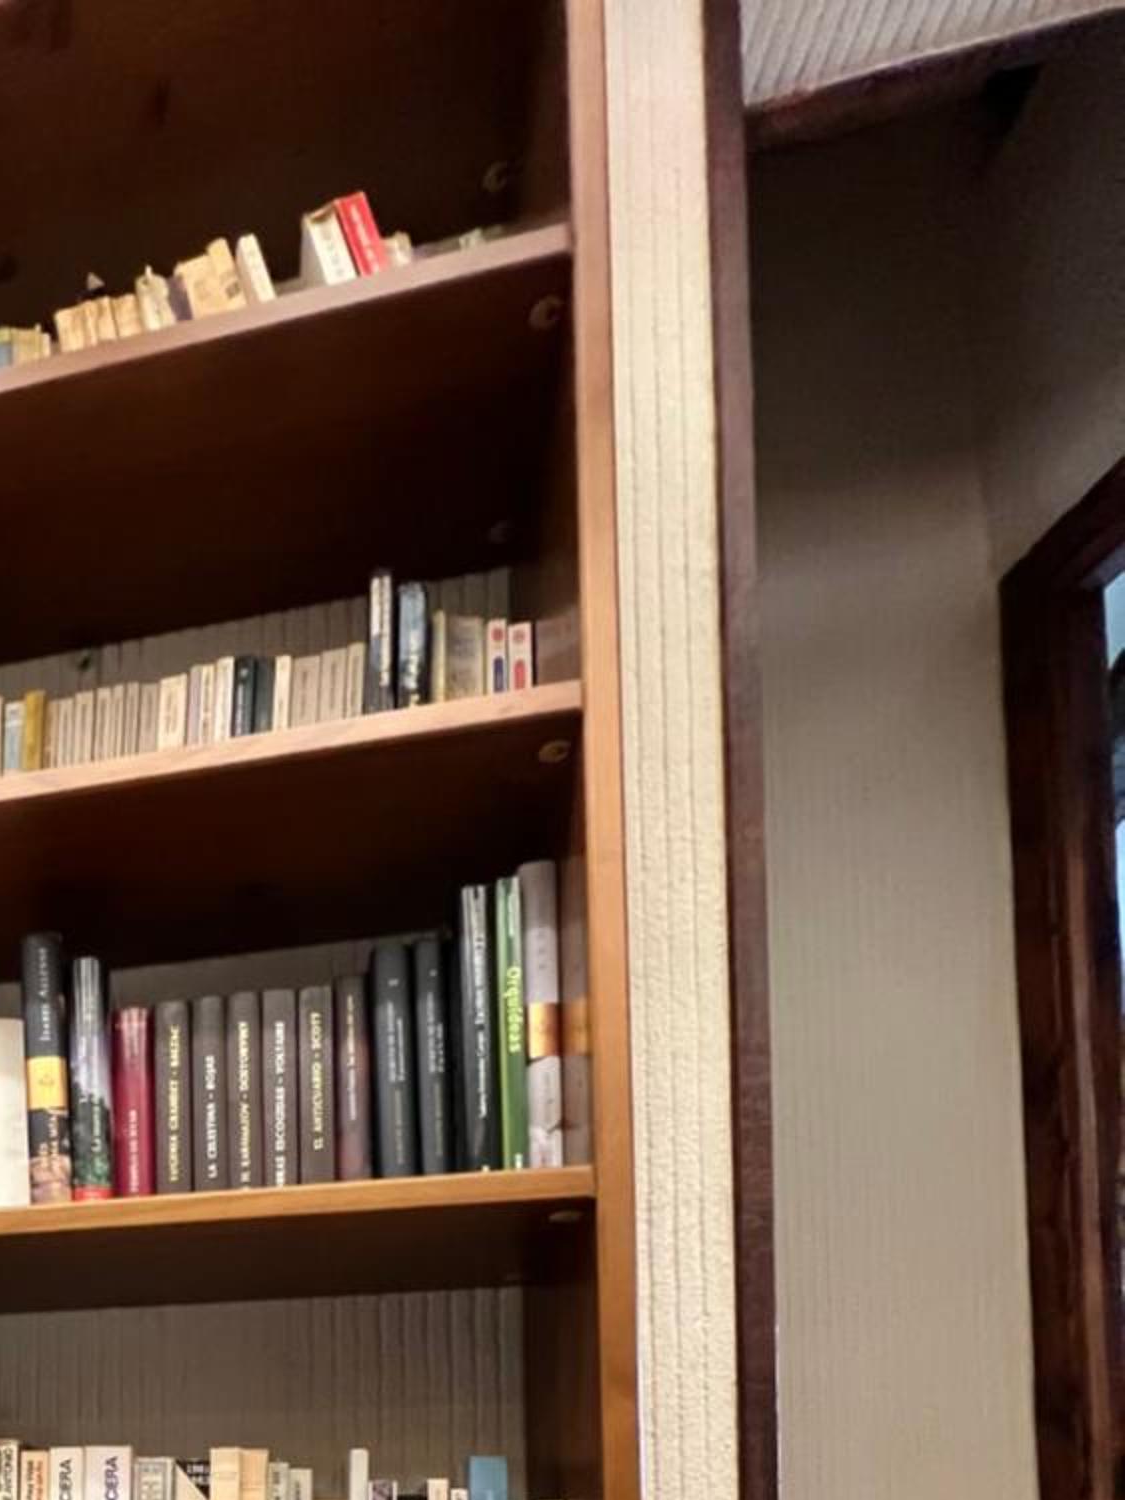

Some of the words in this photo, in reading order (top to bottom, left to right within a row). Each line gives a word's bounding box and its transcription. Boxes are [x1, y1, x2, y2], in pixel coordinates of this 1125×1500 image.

[504, 965, 523, 1054] Orquídeas
[310, 1011, 323, 1051] SCOTT
[313, 1137, 324, 1150] EL
[207, 1163, 218, 1179] LA
